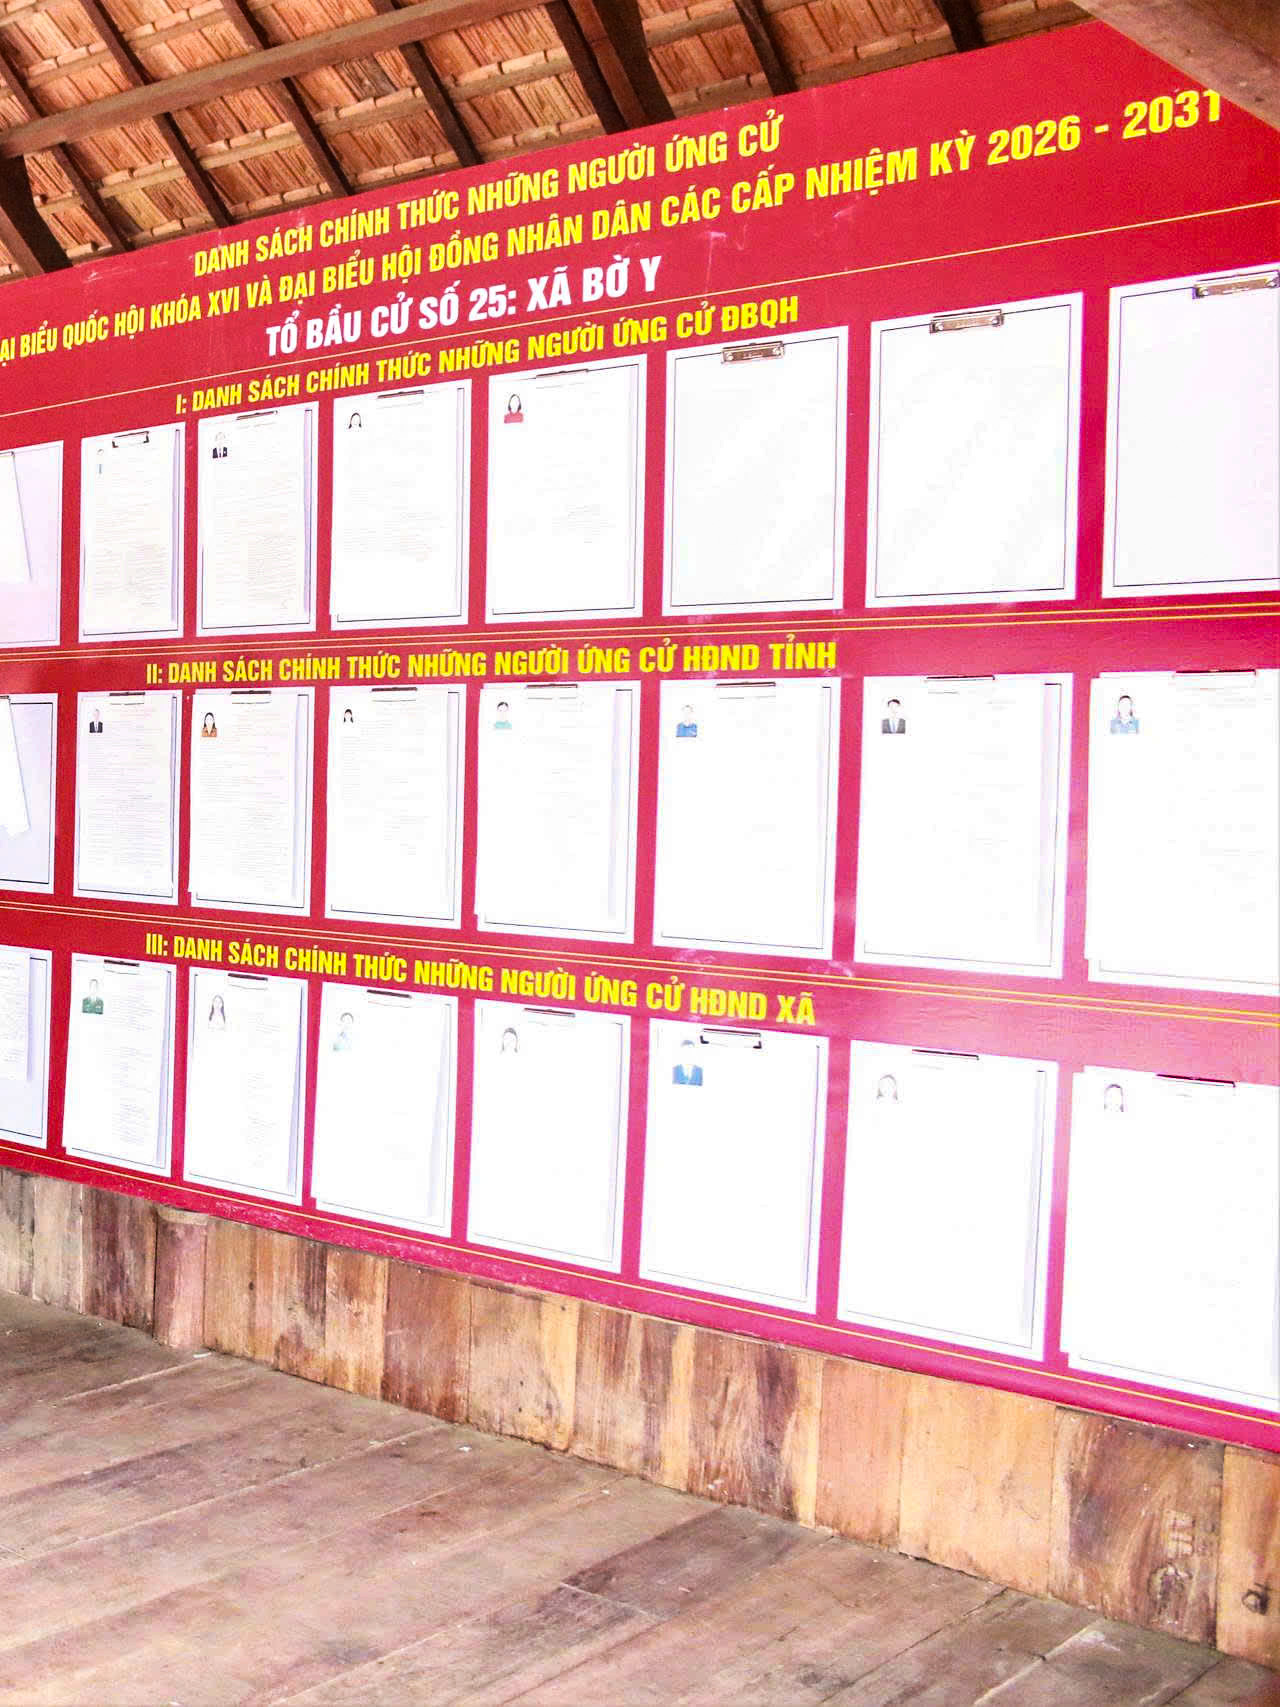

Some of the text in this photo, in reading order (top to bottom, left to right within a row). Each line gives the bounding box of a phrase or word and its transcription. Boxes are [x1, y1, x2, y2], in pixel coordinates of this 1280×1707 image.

[20, 320, 57, 357] BIỂU
[63, 310, 109, 350] QUỐC
[114, 304, 144, 339] HỘI
[150, 293, 201, 329] KHÓA
[207, 286, 239, 317] XVI
[246, 275, 272, 308] VÀ
[279, 270, 315, 304] ĐẠI
[323, 249, 374, 293] BIỂU
[382, 244, 421, 283] HỘI
[429, 230, 498, 272] ĐỒNG
[507, 213, 582, 257] NHÂN
[592, 200, 651, 240] DÂN
[661, 185, 720, 227] CÁC
[732, 164, 794, 213] CẤP
[806, 147, 917, 200] NHIỆM
[930, 130, 976, 176] KỲ
[987, 115, 1080, 165] 2026
[1095, 124, 1109, 133] -
[1123, 87, 1221, 139] 2031
[195, 109, 784, 277] DANH SÁCH CHÍNH THỨC NHỮNG NGƯỜI ỨNG CỬ
[176, 296, 798, 414] I: DANH SÁCH CHÍNH THỨC NHỮNG NGƯỜI ỨNG CỬ ĐBQH
[266, 254, 661, 356] TỔ BẦU CỬ SỐ 25: XÃ BỜ Y
[147, 633, 836, 684] II: DANH SÁCH CHÍNH THỨC NHỮNG NGƯỜI ỨNG CỬ HĐND TỈNH
[146, 933, 816, 1027] III: DANH SÁCH CHÍNH THỨC NHỮNG NGƯỜI ỨNG CỬ HĐND XÃ
